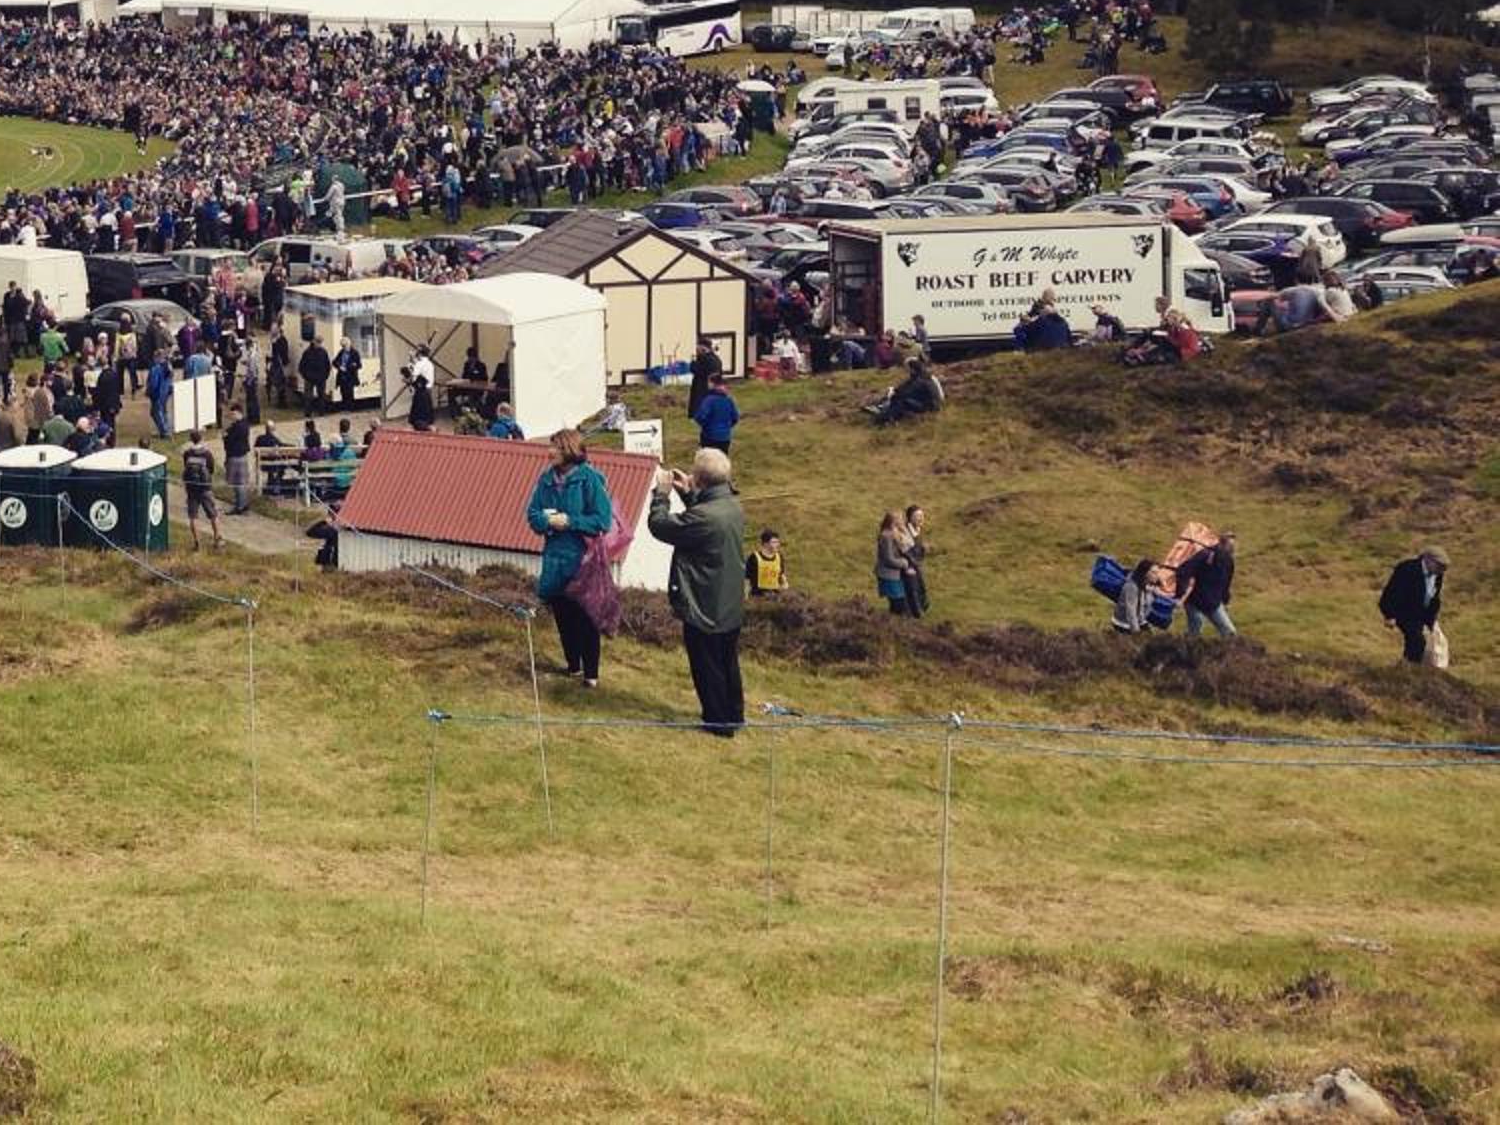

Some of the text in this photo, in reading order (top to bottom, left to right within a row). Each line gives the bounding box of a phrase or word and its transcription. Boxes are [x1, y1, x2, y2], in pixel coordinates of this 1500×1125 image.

[1029, 245, 1079, 263] Whyte
[916, 268, 1136, 290] ROAST BEEF CARVERY
